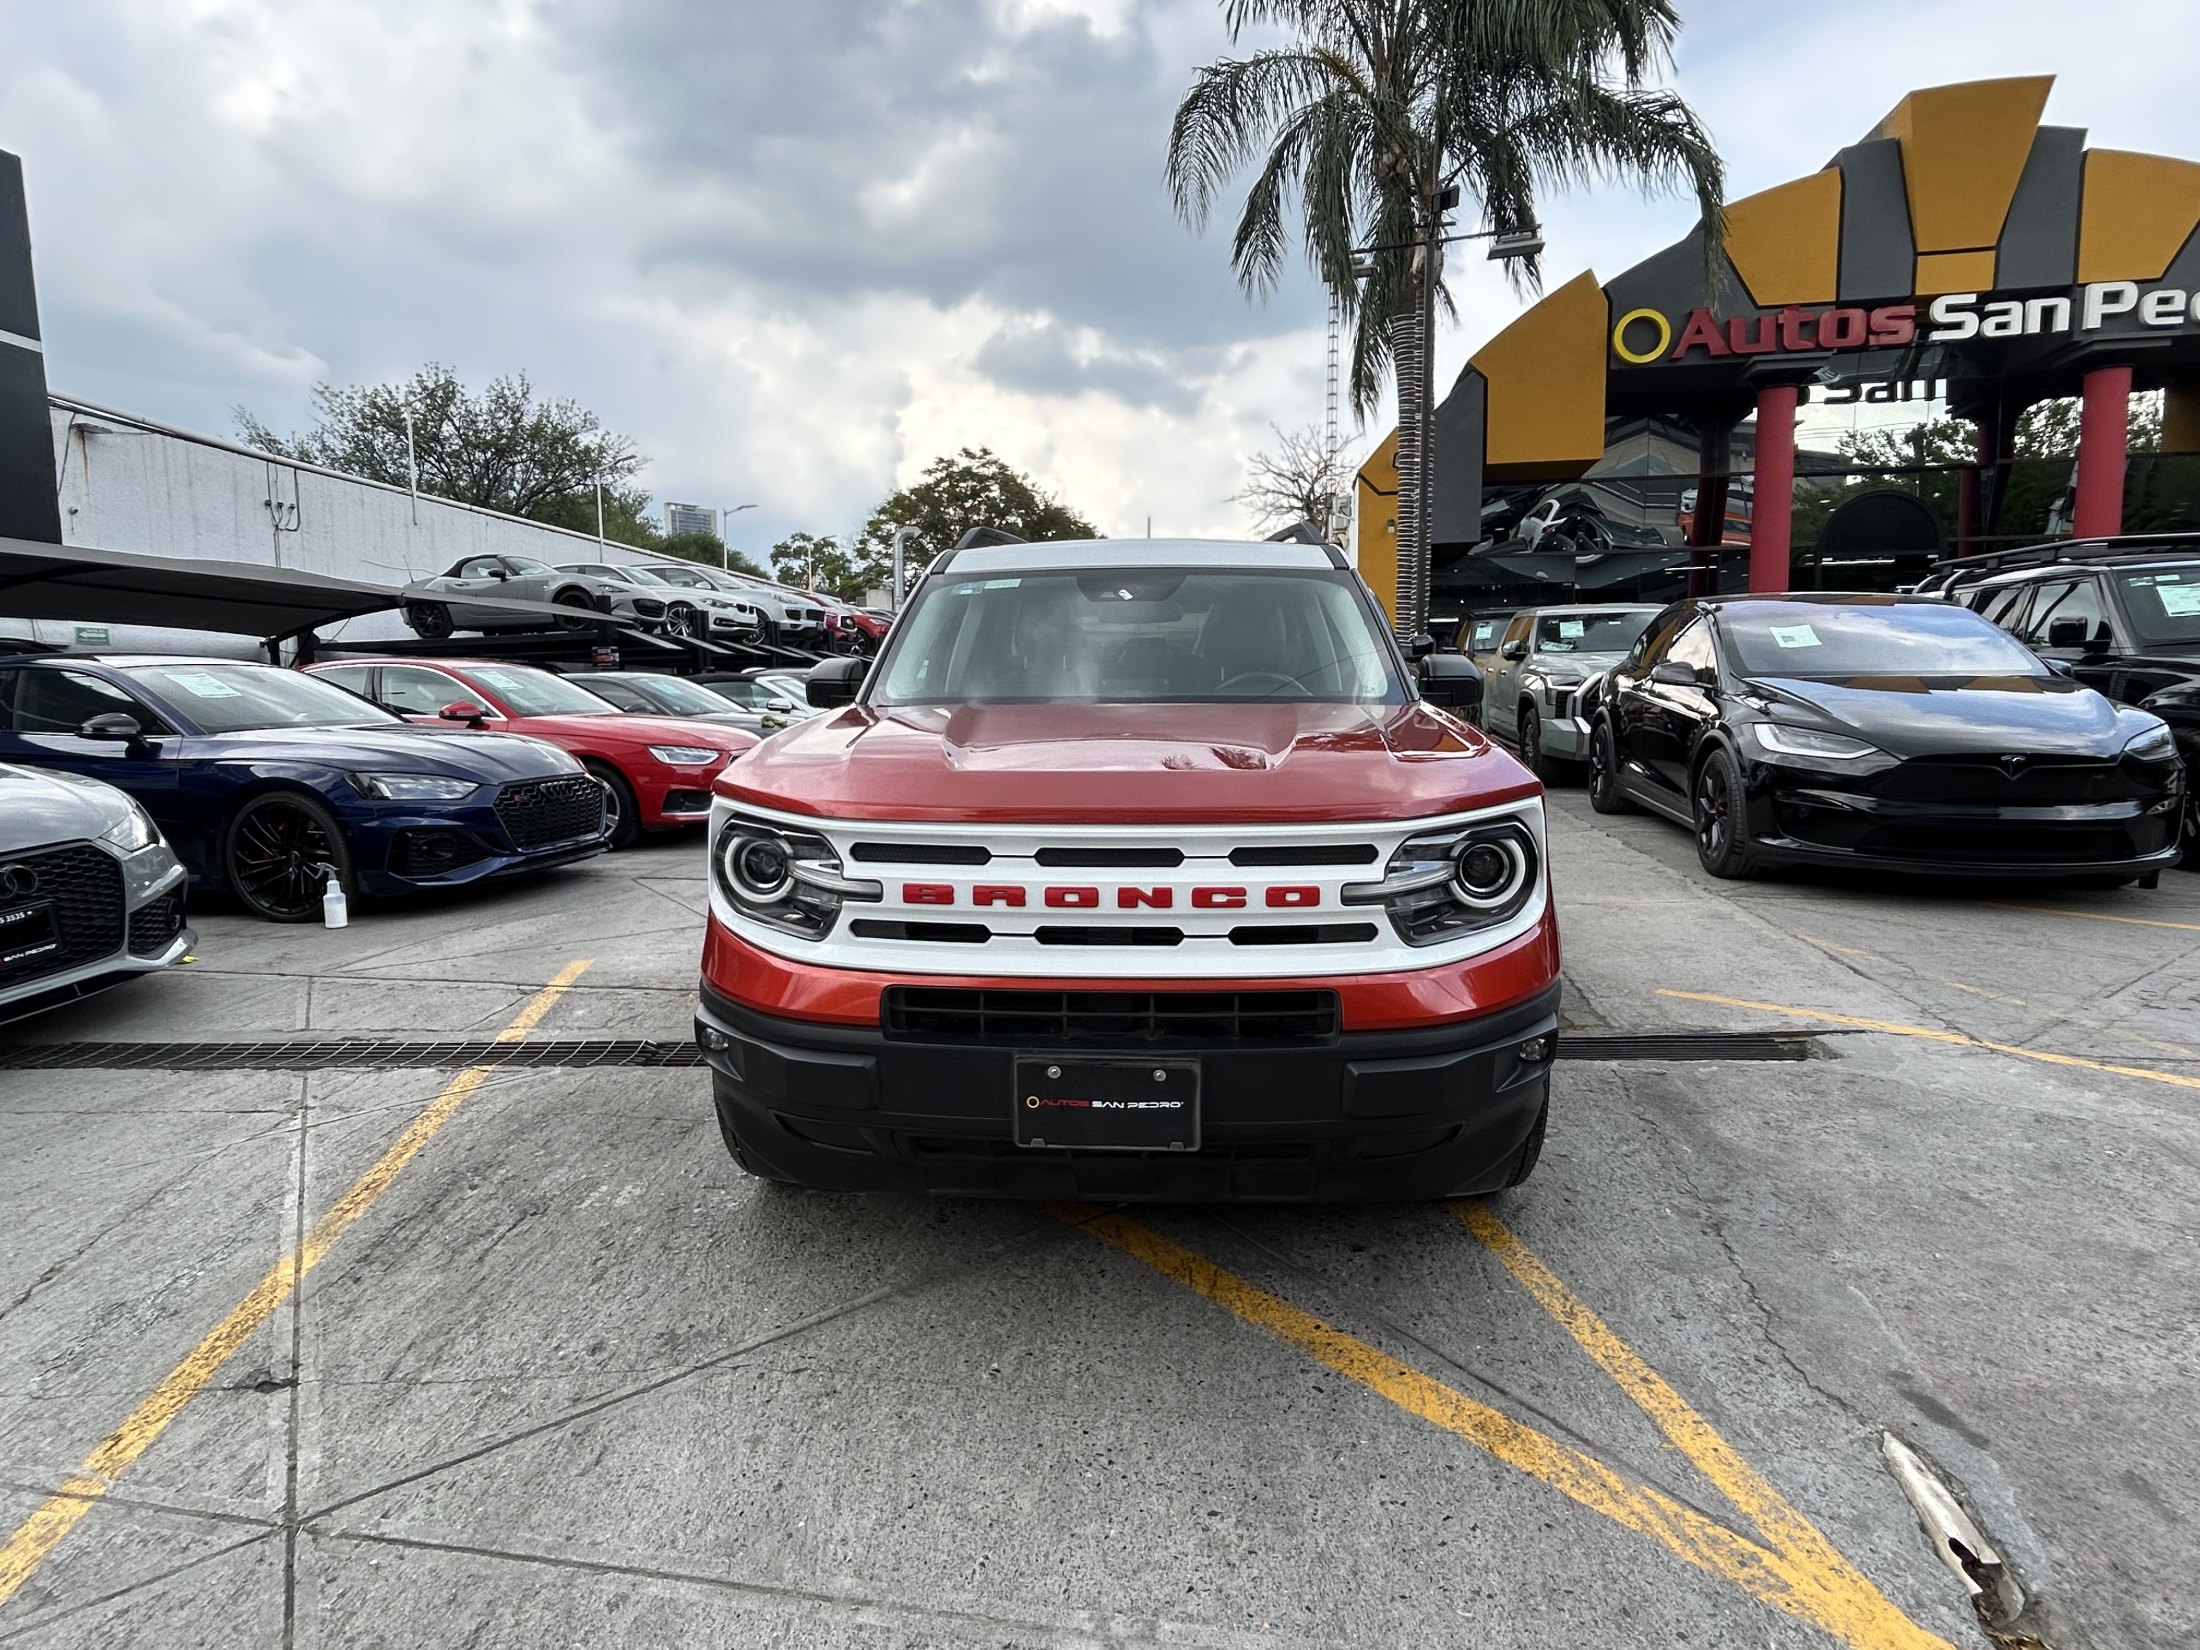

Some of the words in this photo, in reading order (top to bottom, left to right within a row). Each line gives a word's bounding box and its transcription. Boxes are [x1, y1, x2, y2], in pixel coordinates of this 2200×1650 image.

[1670, 304, 1916, 360] Autos
[1929, 293, 2071, 341] San
[2082, 281, 2200, 327] Pe
[902, 883, 1321, 909] BRONCO
[1040, 1099, 1089, 1107] AUTOS
[1091, 1100, 1125, 1109] SAN
